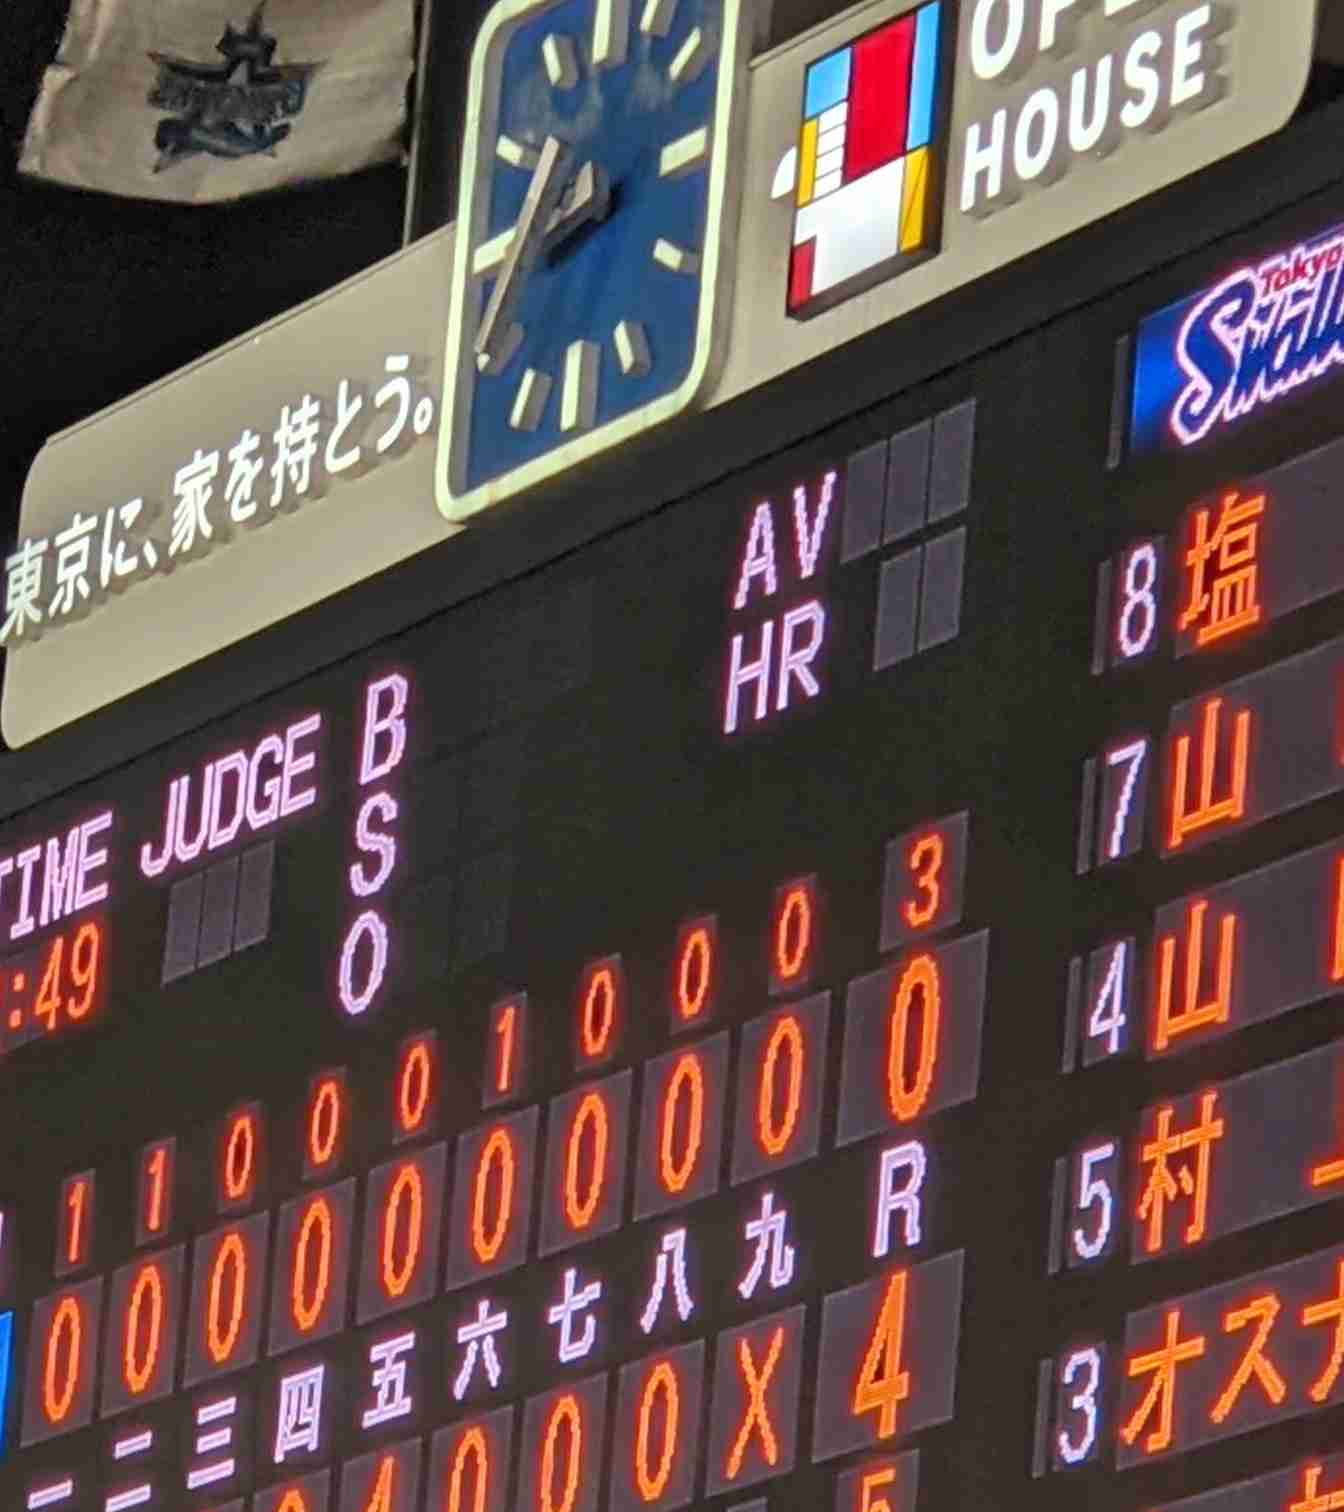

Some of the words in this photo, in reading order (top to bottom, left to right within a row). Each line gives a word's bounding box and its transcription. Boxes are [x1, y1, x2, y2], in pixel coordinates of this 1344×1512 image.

[960, 5, 1211, 212] HOUSE
[1259, 243, 1344, 298] Tokyo
[1118, 542, 1157, 657] 8
[724, 602, 827, 737] HR
[360, 673, 409, 786] B
[140, 713, 322, 876] JUDGE
[349, 792, 398, 897] S
[1106, 740, 1147, 859] 7
[68, 1181, 87, 1263] 1
[146, 1149, 166, 1232] 1
[226, 1114, 254, 1199] 0
[311, 1080, 340, 1165] 0
[400, 1040, 430, 1130] 0
[496, 1006, 515, 1092] 1
[583, 968, 614, 1057] 0
[679, 928, 710, 1018] 0
[778, 887, 810, 978] 0
[906, 832, 945, 928] 3
[1088, 941, 1127, 1053] 4
[44, 1297, 81, 1424] 0
[124, 1263, 162, 1395] 0
[208, 1231, 245, 1364] 0
[293, 1198, 332, 1332] 0
[383, 1164, 423, 1297] 0
[472, 1127, 513, 1264] 0
[564, 1092, 607, 1230] 0
[660, 1053, 704, 1193] 0
[758, 1014, 804, 1155] 0
[888, 952, 941, 1122] 0
[1073, 1142, 1116, 1260] 5
[187, 1395, 237, 1491] 三
[274, 1363, 325, 1464] 四
[361, 1331, 417, 1430] 五
[455, 1299, 508, 1400] 六
[547, 1267, 602, 1364] 七
[639, 1227, 694, 1335] 八
[737, 1191, 796, 1300] 九
[872, 1139, 928, 1259] R
[635, 1361, 679, 1501] 0
[725, 1326, 784, 1482] X
[852, 1269, 911, 1440] 4
[1059, 1347, 1101, 1464] 3
